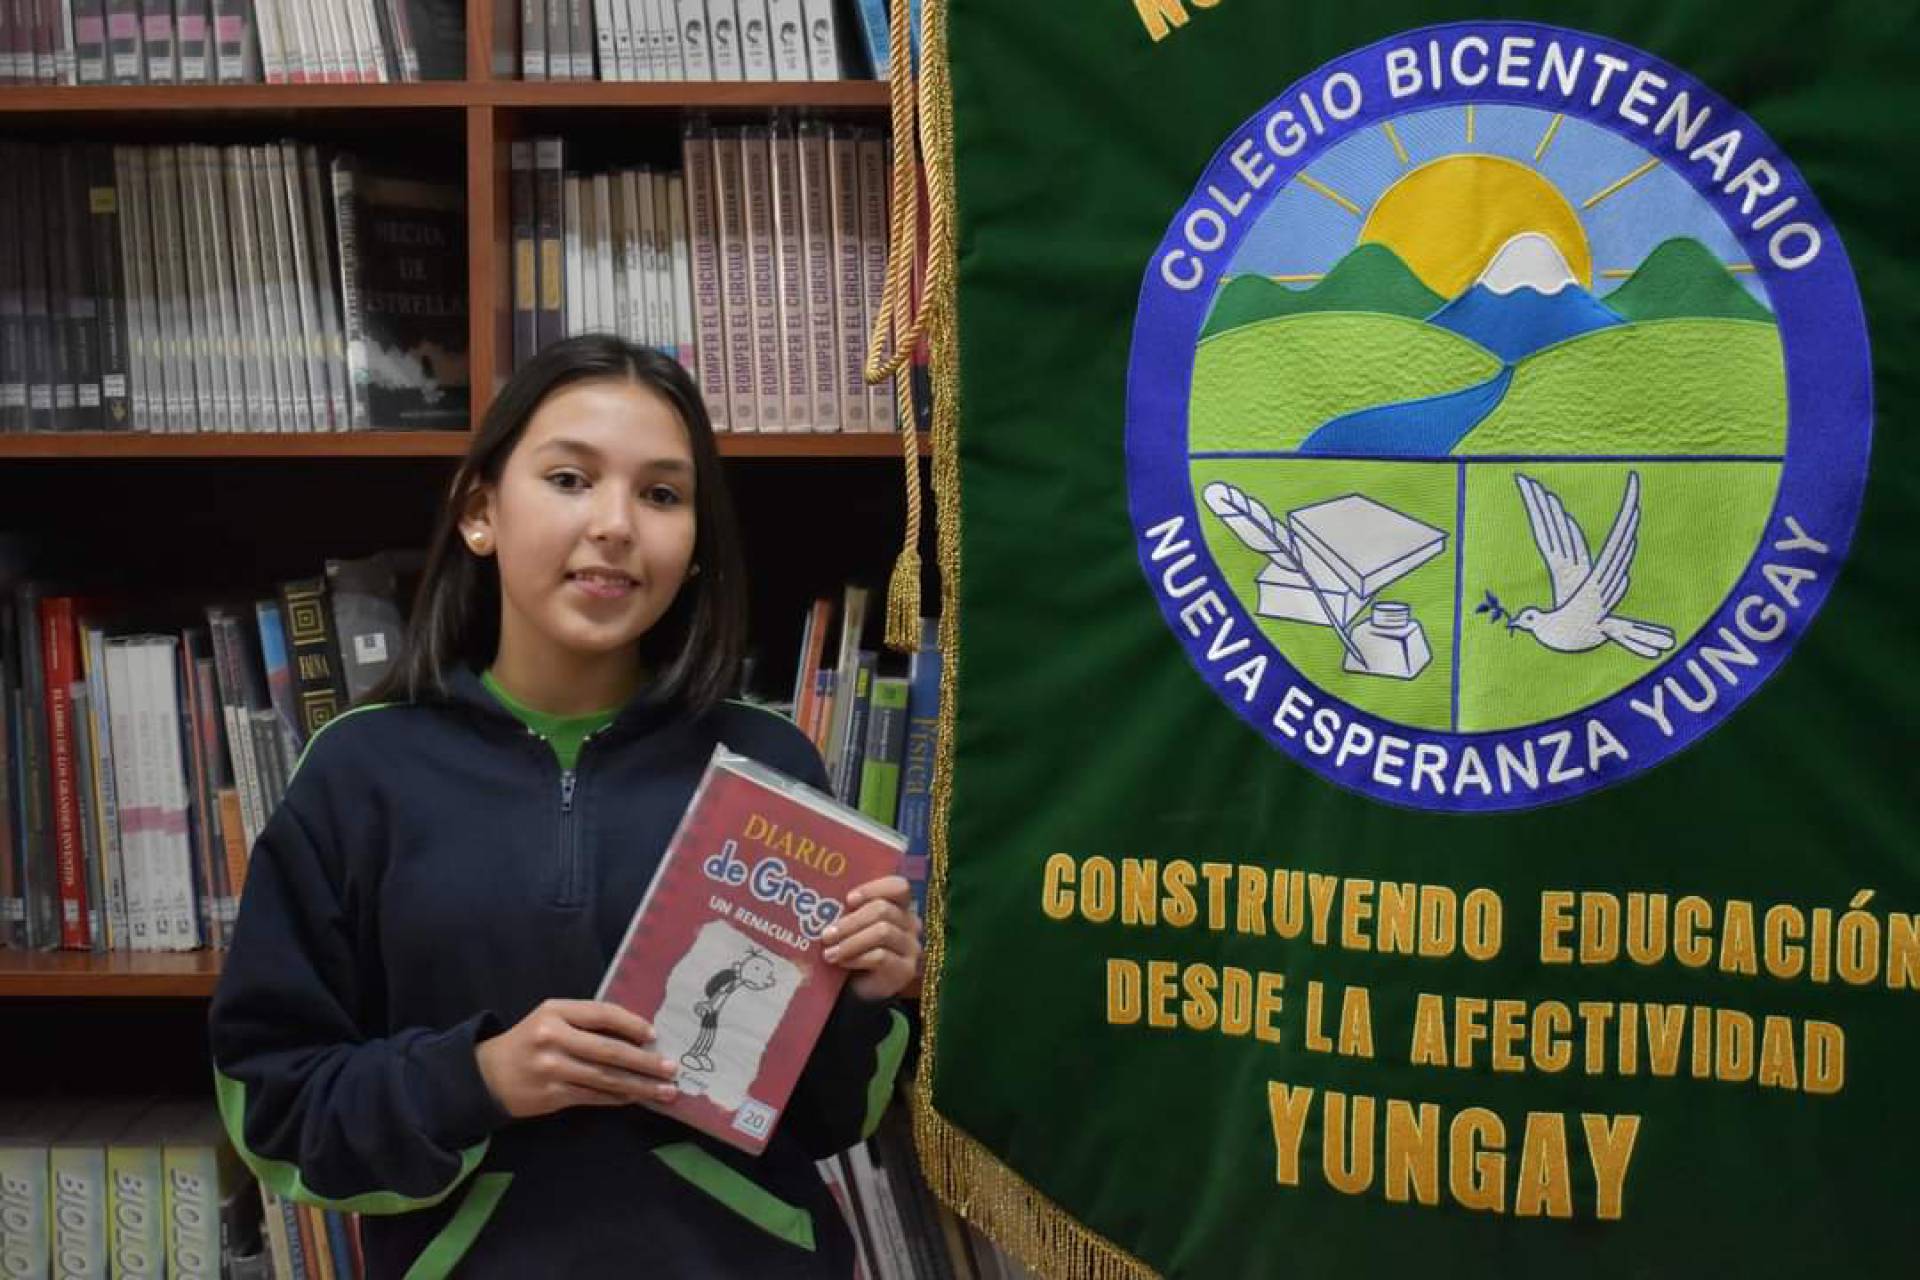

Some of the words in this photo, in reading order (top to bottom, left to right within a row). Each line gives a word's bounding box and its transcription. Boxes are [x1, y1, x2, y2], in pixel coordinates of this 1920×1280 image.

[1160, 72, 1362, 290] COLEGIO
[1386, 36, 1822, 270] BICENTENARIO
[702, 312, 719, 328] EL
[731, 312, 748, 328] EL
[758, 312, 776, 329] EL
[786, 313, 802, 328] EL
[813, 311, 830, 326] EL
[845, 312, 861, 329] EL
[703, 333, 724, 394] ROMPER
[732, 333, 752, 394] ROMPER
[759, 335, 779, 395] ROMPER
[788, 335, 806, 395] ROMPER
[815, 331, 833, 392] ROMPER
[847, 335, 863, 395] ROMPER
[1145, 516, 1269, 702] NUEVA
[1272, 686, 1629, 796] ESPERANZA
[1629, 515, 1830, 737] YUNGAY
[744, 813, 846, 876] DIARIO
[703, 839, 748, 886] de
[750, 857, 845, 940] Greg
[709, 896, 733, 915] UN
[1041, 853, 1503, 961] CONSTRUYENDO
[1540, 889, 1920, 989] EDUCACIÓN
[1107, 958, 1286, 1044] DESDE
[1306, 981, 1375, 1058] LA
[1410, 993, 1845, 1095] AFECTIVIDAD
[742, 1110, 767, 1130] 20
[1267, 1080, 1641, 1220] YUNGAY
[0, 1171, 33, 1280] BIOLO
[55, 1167, 88, 1280] BIOLO
[113, 1167, 146, 1280] BIOLO
[170, 1167, 202, 1280] BIOLO
